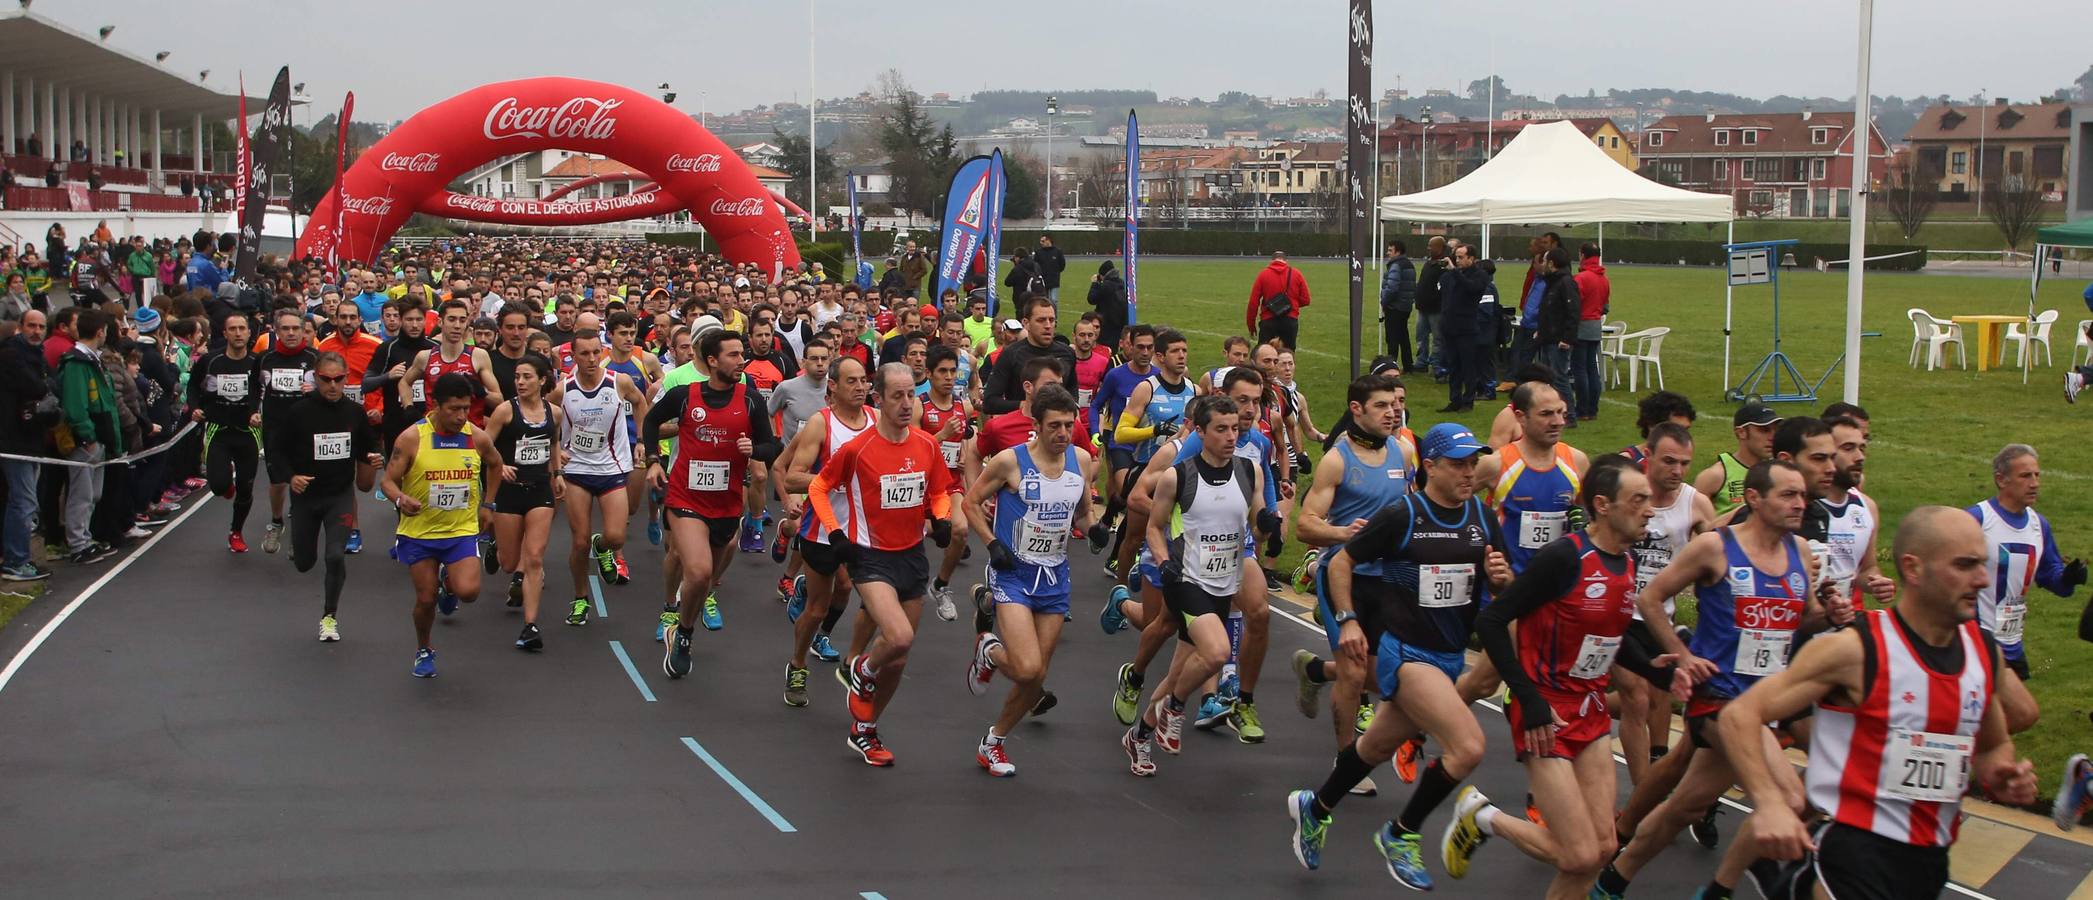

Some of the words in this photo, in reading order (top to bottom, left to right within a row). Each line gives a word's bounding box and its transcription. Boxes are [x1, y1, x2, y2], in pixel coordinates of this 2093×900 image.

[483, 97, 624, 140] Coca-Cola
[382, 152, 440, 172] Coca-Cola
[666, 153, 722, 172] Coca-Cola
[448, 194, 496, 213] Coca-Cola
[502, 202, 525, 214] CON
[528, 202, 541, 214] EL
[544, 201, 593, 215] DEPORTE
[594, 192, 655, 212] ASTURIANO
[711, 197, 765, 216] Coca-Cola
[948, 228, 962, 258] GRUPO
[942, 257, 955, 279] REAL
[222, 382, 239, 393] 425
[575, 434, 593, 448] 309
[318, 443, 341, 457] 1043
[521, 448, 539, 460] 623
[425, 469, 473, 480] ECUADOR
[697, 472, 715, 486] 213
[437, 494, 455, 506] 137
[887, 487, 914, 503] 1427
[1200, 532, 1240, 542] ROCES
[1532, 527, 1550, 542] 35
[1028, 538, 1052, 552] 228
[1206, 557, 1227, 573] 474
[1434, 582, 1453, 600] 30
[1754, 649, 1770, 668] 13
[1901, 758, 1946, 790] 200
